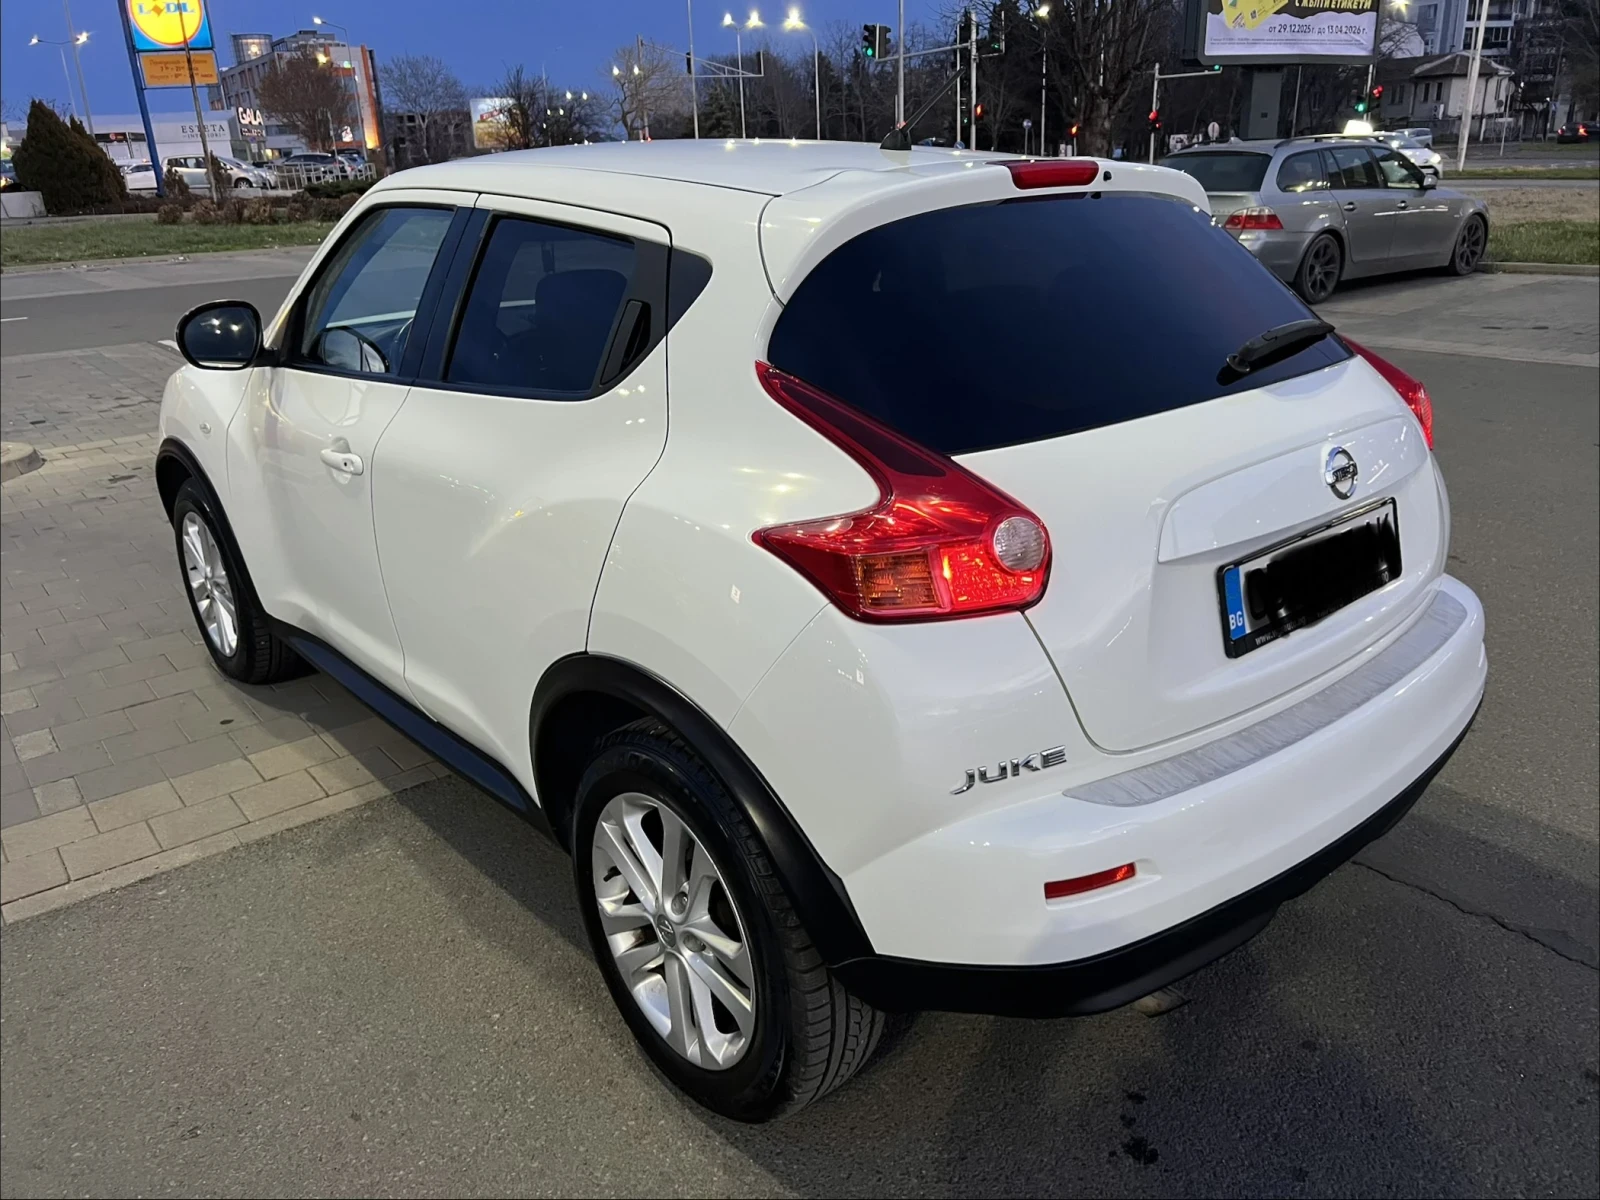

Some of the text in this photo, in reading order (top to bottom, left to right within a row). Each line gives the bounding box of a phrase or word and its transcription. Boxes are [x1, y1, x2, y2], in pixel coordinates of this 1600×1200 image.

[1317, 27, 1326, 35] до
[238, 107, 264, 125] GALA
[181, 124, 225, 134] ESTETA
[1229, 611, 1243, 630] BG
[950, 744, 1067, 795] JUKE
